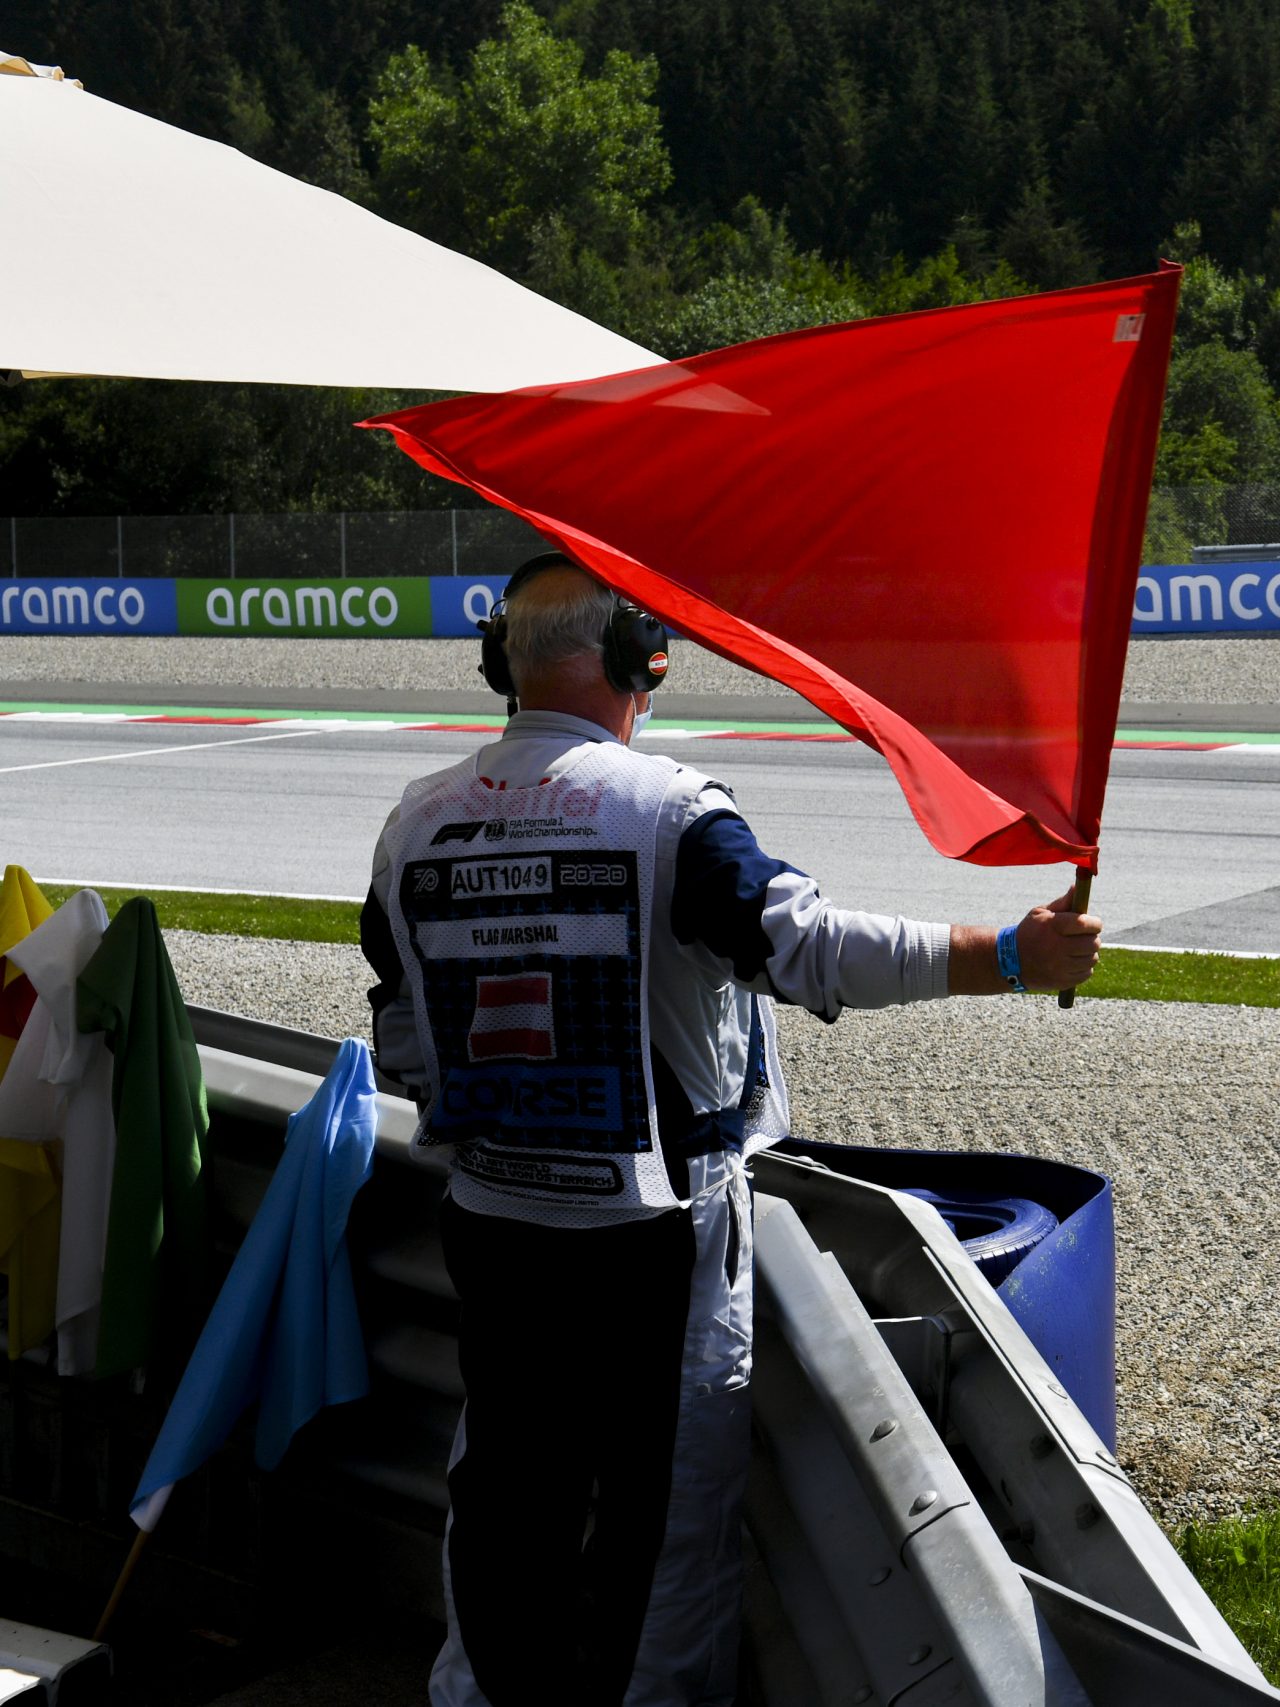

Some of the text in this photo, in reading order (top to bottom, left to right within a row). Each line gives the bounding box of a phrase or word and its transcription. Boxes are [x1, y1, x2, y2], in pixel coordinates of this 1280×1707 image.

[2, 586, 145, 625] ramco
[206, 586, 399, 627] aramco
[509, 820, 523, 829] FIA
[524, 818, 557, 828] Formula
[509, 828, 533, 839] World
[534, 826, 593, 838] Championship
[560, 864, 628, 886] 2020
[472, 925, 559, 946] FLAG MARSHAL
[442, 1077, 608, 1118] CORSE
